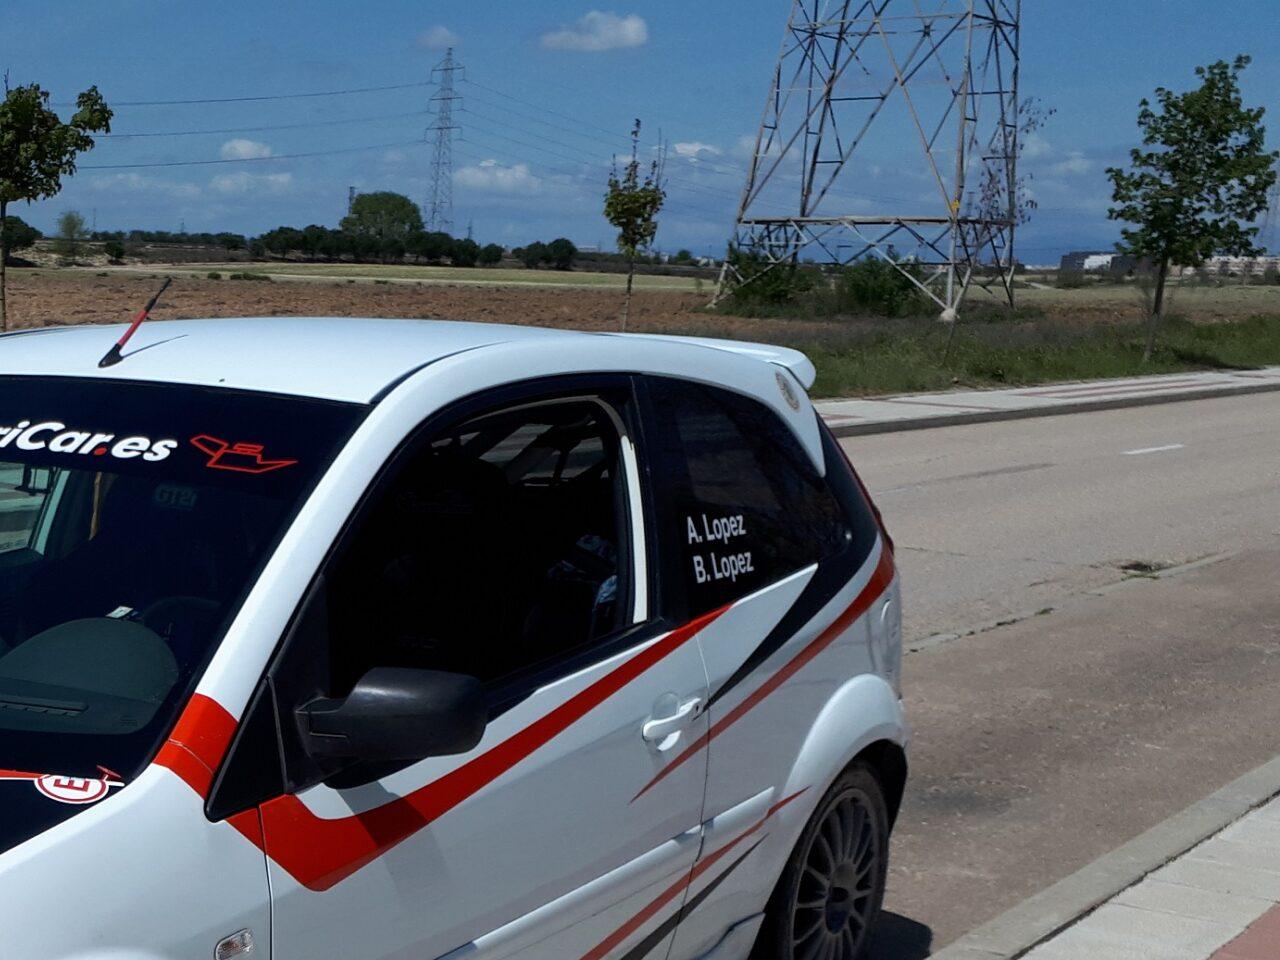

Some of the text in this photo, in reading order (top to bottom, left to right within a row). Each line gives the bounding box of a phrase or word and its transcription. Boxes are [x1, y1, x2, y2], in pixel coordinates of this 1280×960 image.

[687, 514, 746, 544] A. Lopez
[693, 552, 754, 583] B. Lopez
